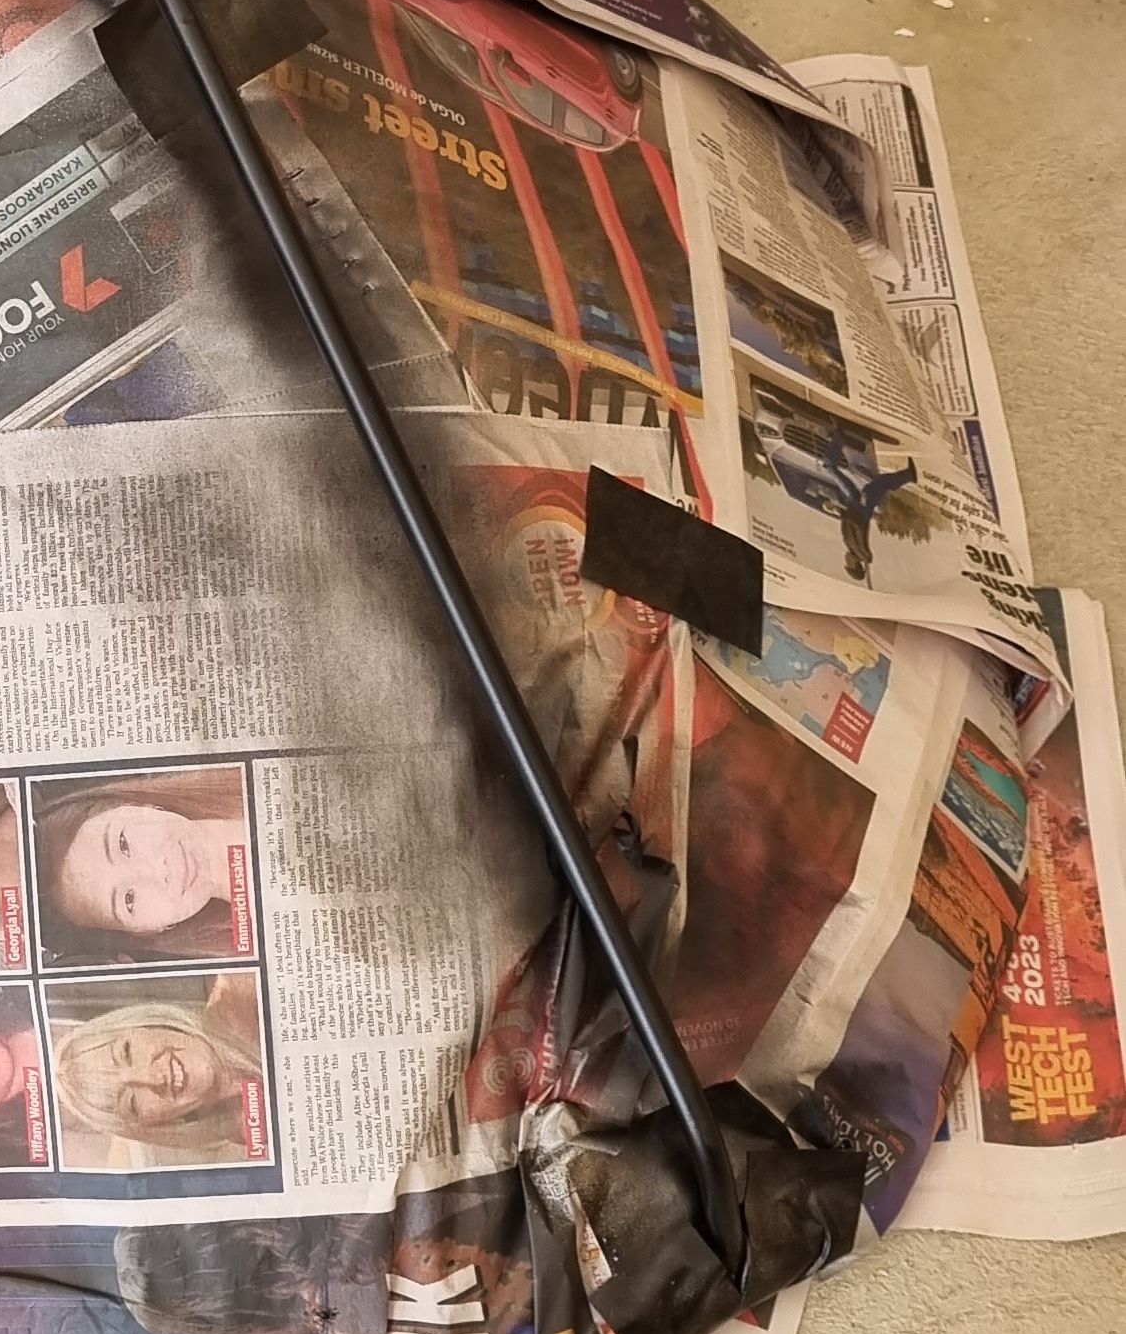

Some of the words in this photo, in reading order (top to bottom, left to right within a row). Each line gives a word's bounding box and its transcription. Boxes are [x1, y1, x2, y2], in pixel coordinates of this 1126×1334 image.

[339, 60, 408, 99] MOELLER
[410, 88, 428, 105] de
[432, 97, 467, 127] OLGA
[363, 92, 510, 193] Street
[33, 178, 99, 230] BRISBANE
[60, 243, 123, 313] 7
[27, 312, 66, 345] YOUR
[553, 537, 588, 607] NOW!
[964, 543, 1009, 569] life
[0, 626, 7, 641] and
[0, 644, 9, 669] family
[12, 682, 20, 715] violence
[47, 657, 56, 709] International
[230, 845, 246, 891] Lasaker
[4, 889, 18, 916] Lyall
[232, 890, 250, 952] Emmerich
[6, 915, 22, 963] Georgia
[304, 946, 313, 978] happen.
[1019, 933, 1046, 1007] 2023
[323, 1071, 332, 1097] family
[1001, 1014, 1037, 1123] WEST
[1026, 1025, 1068, 1125] TECH
[1057, 1027, 1099, 1121] FEST
[25, 1068, 42, 1117] Woodley
[246, 1081, 261, 1130] Cannon
[305, 1095, 314, 1131] available
[334, 1079, 343, 1121] homicides
[27, 1116, 46, 1160] Tiffany
[248, 1129, 264, 1158] Lynn
[308, 1135, 316, 1157] latest
